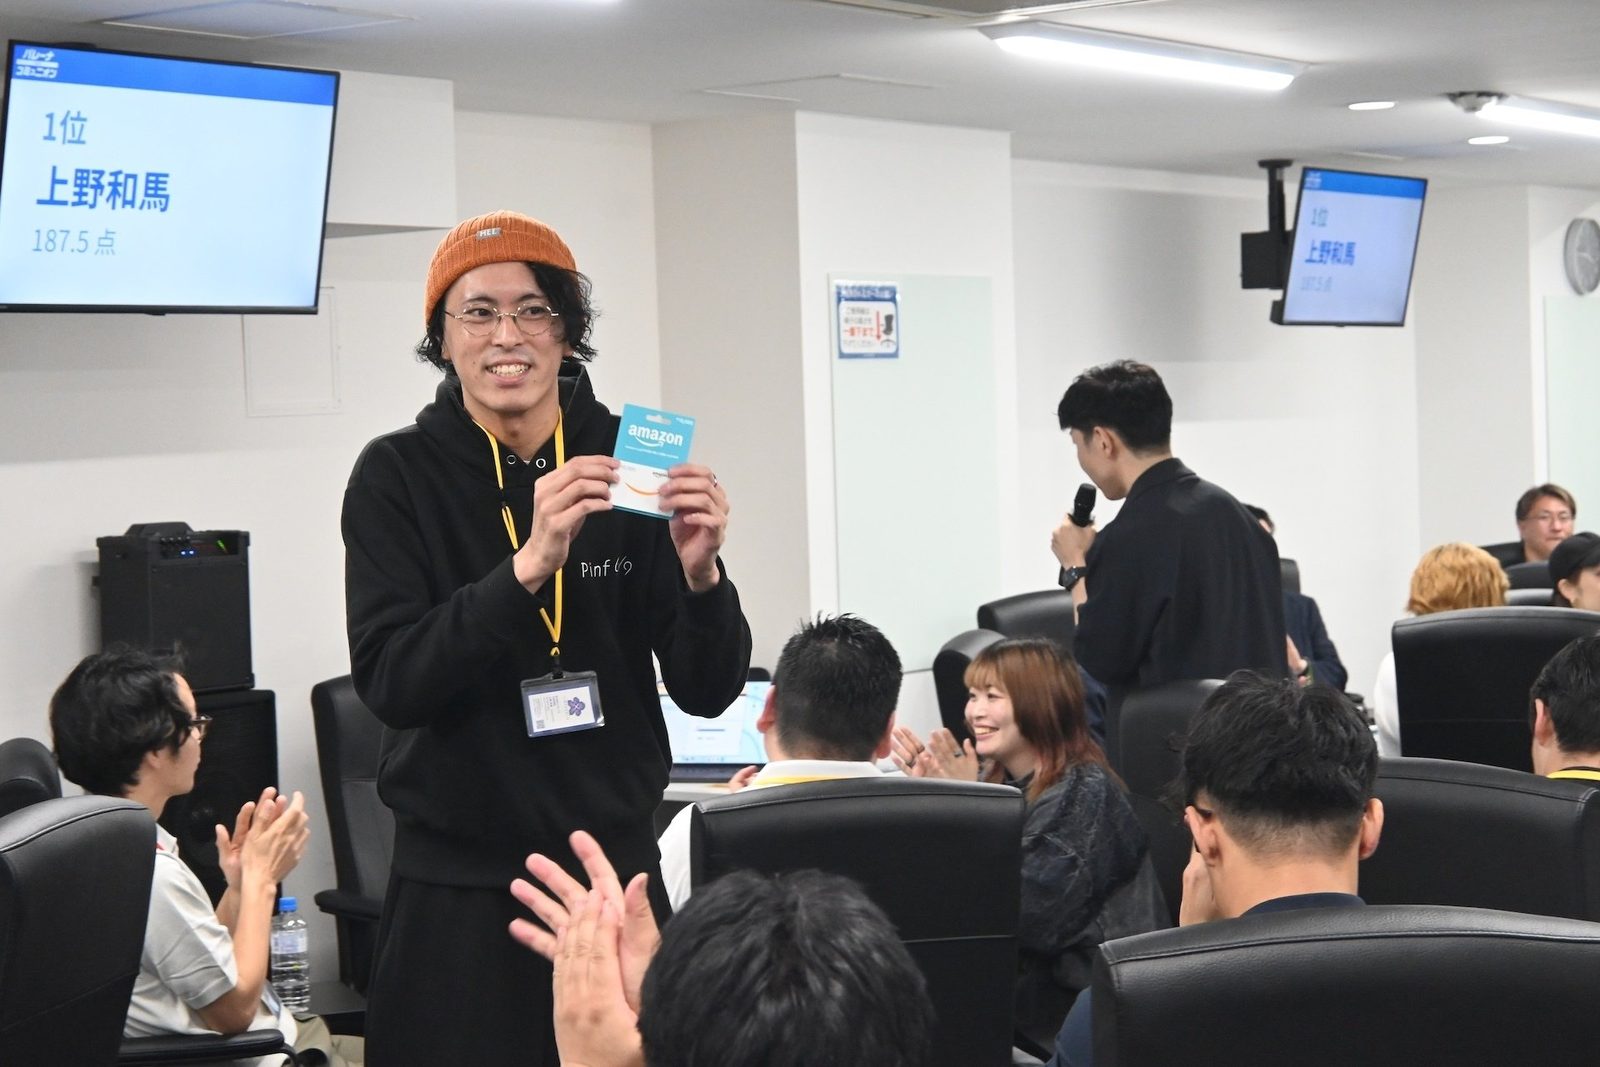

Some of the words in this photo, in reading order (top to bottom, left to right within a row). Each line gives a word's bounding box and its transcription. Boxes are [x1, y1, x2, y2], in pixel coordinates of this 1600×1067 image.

[42, 110, 87, 145] 1位
[36, 165, 170, 213] 上野和馬
[628, 424, 683, 446] amazon
[580, 559, 611, 578] Pinf
